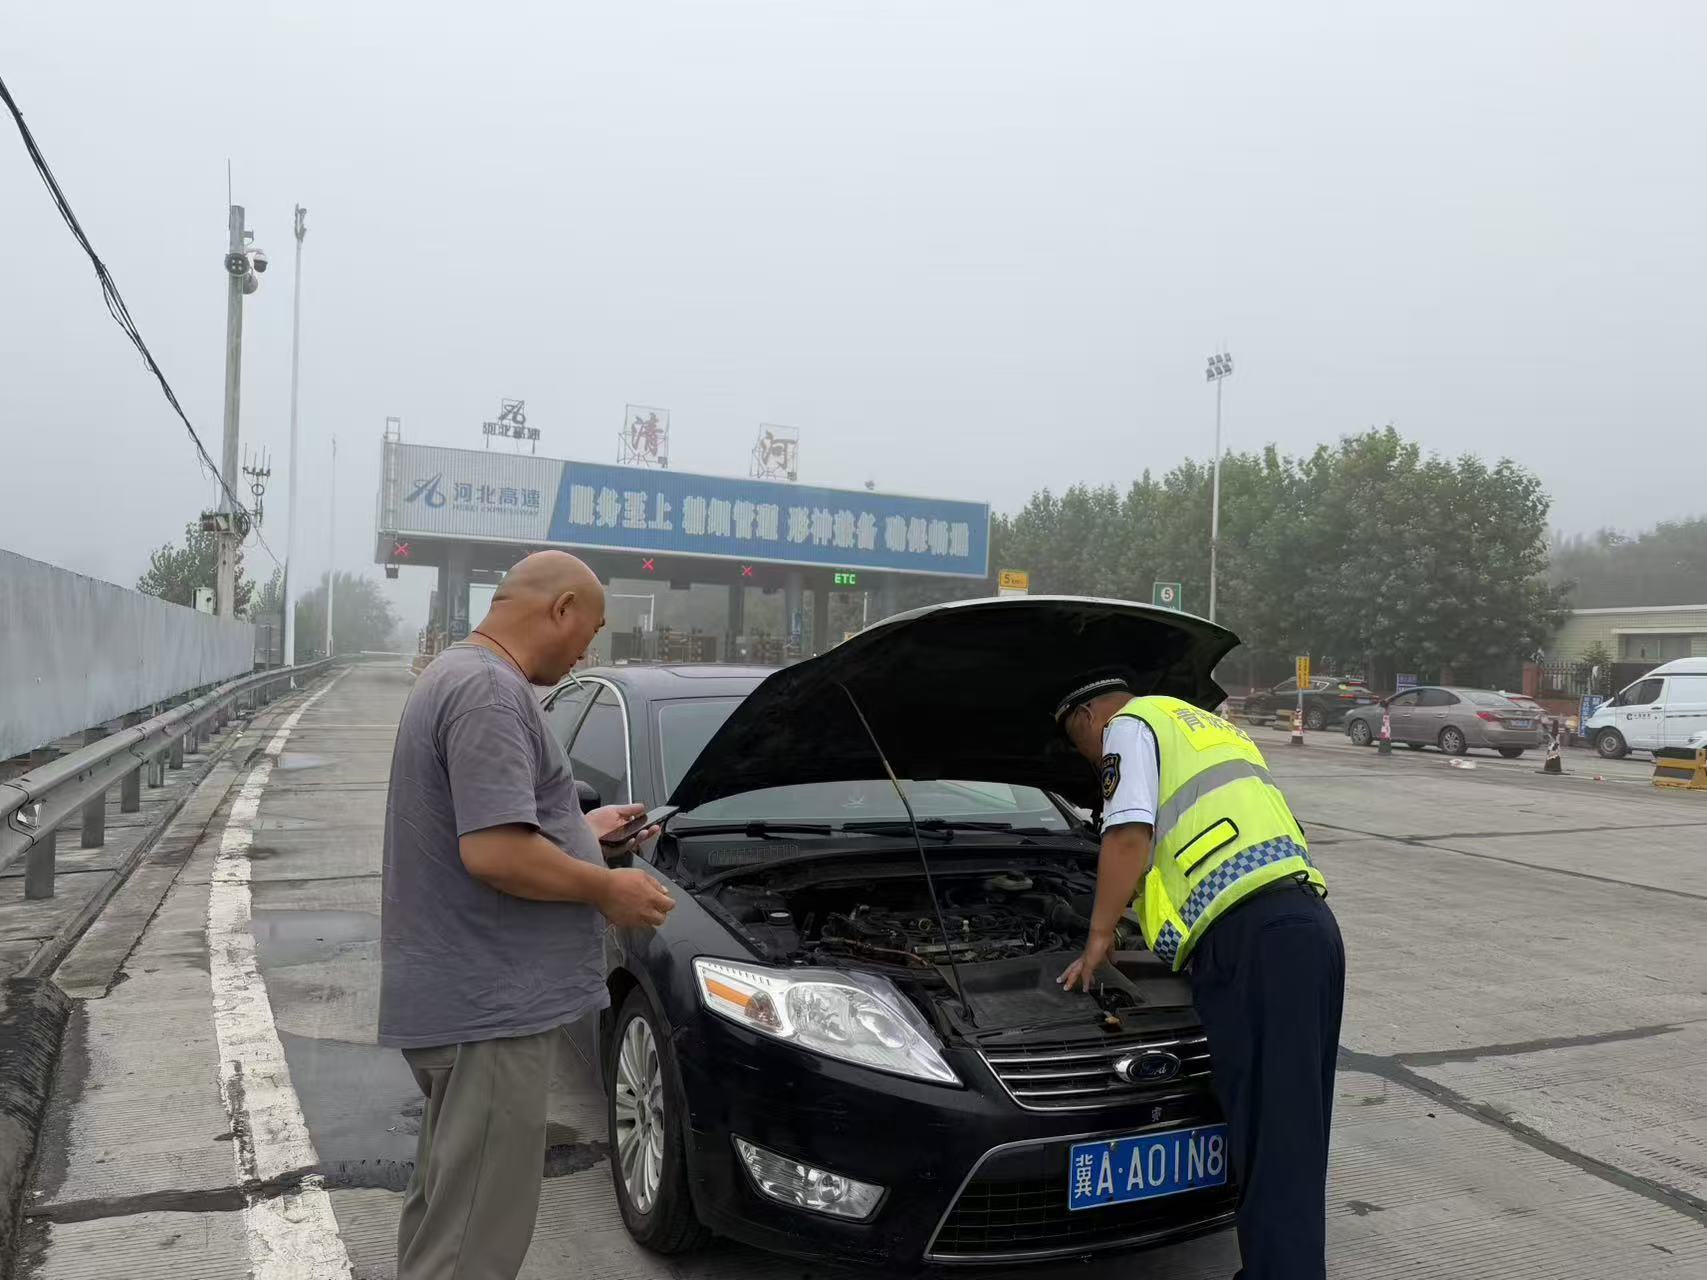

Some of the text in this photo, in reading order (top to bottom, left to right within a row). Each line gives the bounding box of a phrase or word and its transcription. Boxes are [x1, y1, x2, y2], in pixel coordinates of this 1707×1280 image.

[631, 412, 797, 470] 清 河
[453, 482, 540, 508] 河北高速
[834, 573, 856, 585] ETC
[1164, 589, 1172, 600] 5
